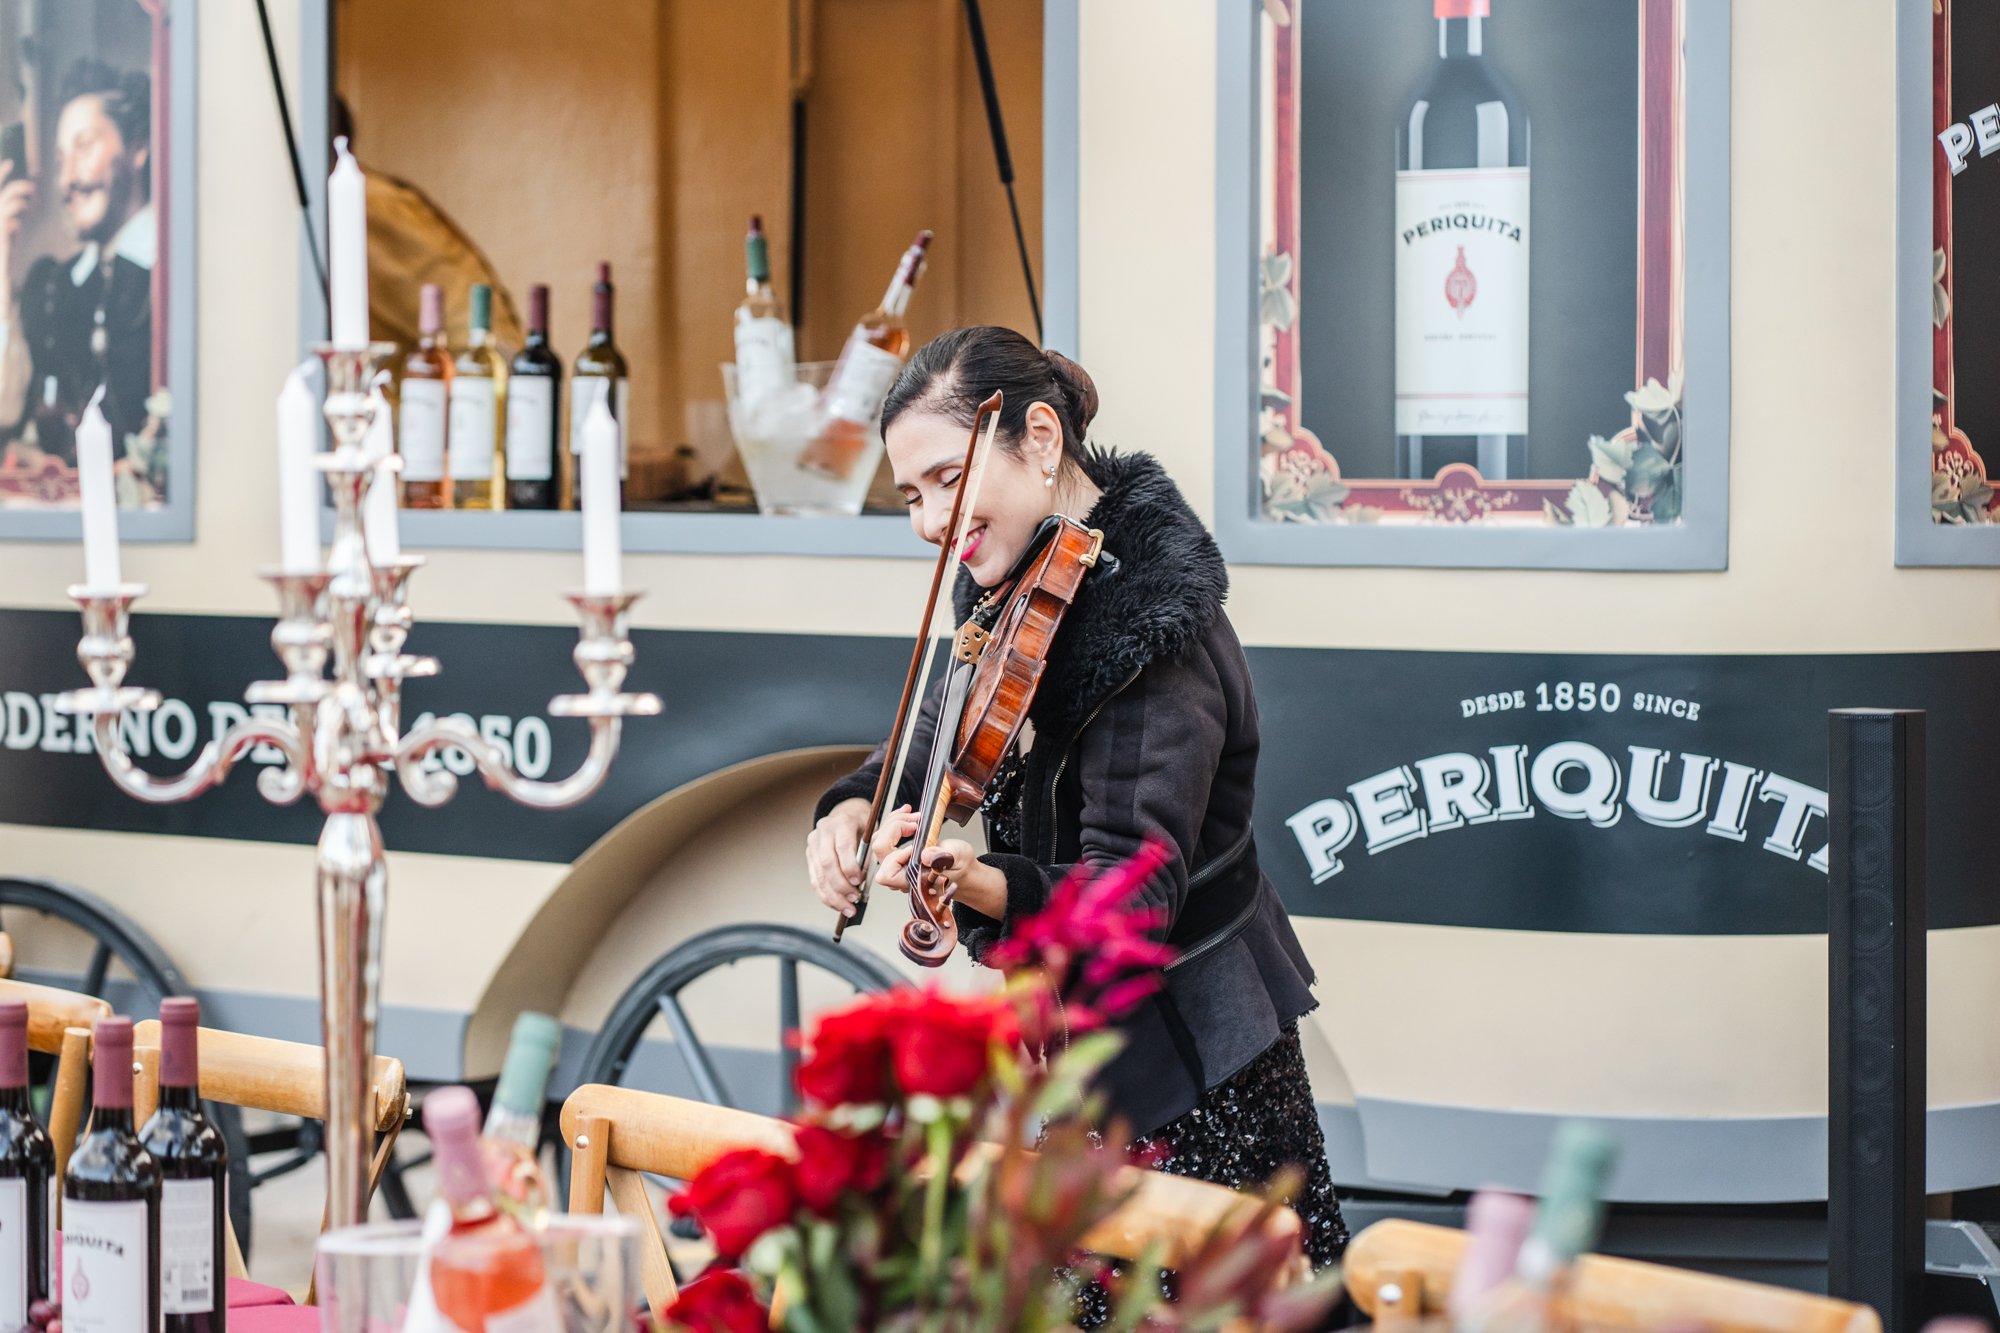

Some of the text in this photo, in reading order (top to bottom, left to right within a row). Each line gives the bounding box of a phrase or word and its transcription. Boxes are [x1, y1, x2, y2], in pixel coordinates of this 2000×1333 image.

[1402, 214, 1522, 246] PERIQUITA
[0, 691, 197, 760] DENO
[1460, 681, 1701, 721] DESDE 1850 SINCE
[1285, 741, 1829, 886] PERIQUIT
